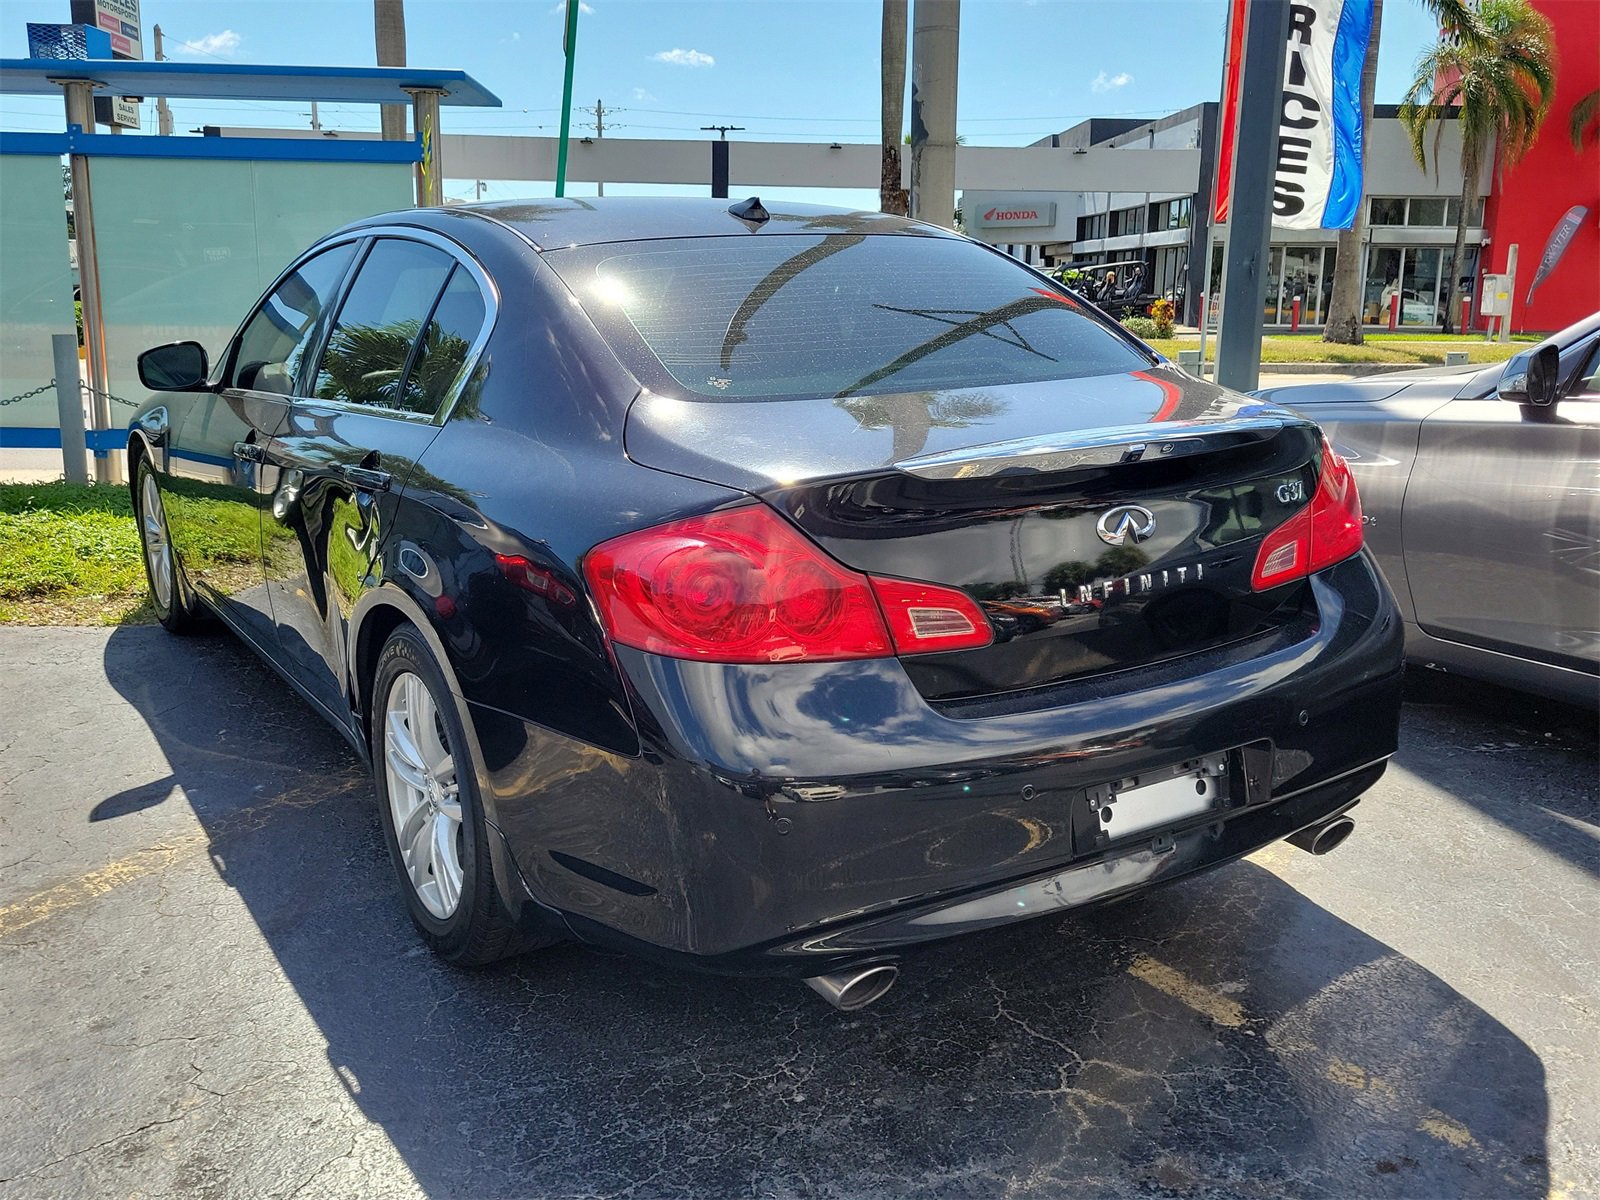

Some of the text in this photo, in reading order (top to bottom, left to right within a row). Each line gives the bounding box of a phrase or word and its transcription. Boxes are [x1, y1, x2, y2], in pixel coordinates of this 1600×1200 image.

[118, 103, 134, 114] SALES
[116, 113, 138, 126] SERVICE
[996, 210, 1038, 220] HONDA
[1276, 481, 1302, 503] G37
[1060, 563, 1204, 607] INFINITI
